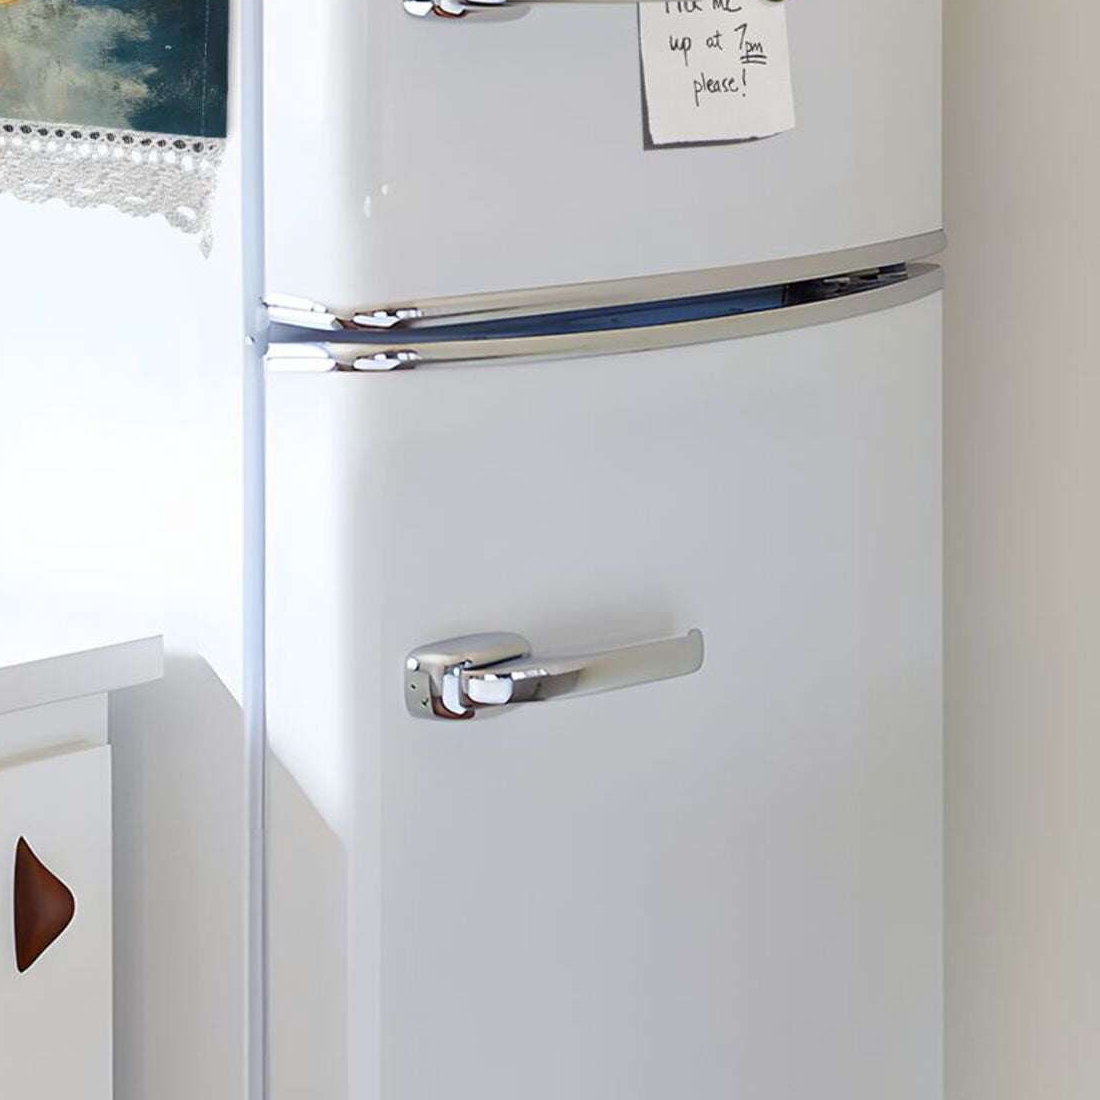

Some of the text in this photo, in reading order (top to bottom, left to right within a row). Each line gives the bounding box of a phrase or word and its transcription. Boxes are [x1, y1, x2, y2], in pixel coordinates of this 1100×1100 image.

[669, 23, 764, 66] up at 7pm
[694, 68, 747, 107] please!
